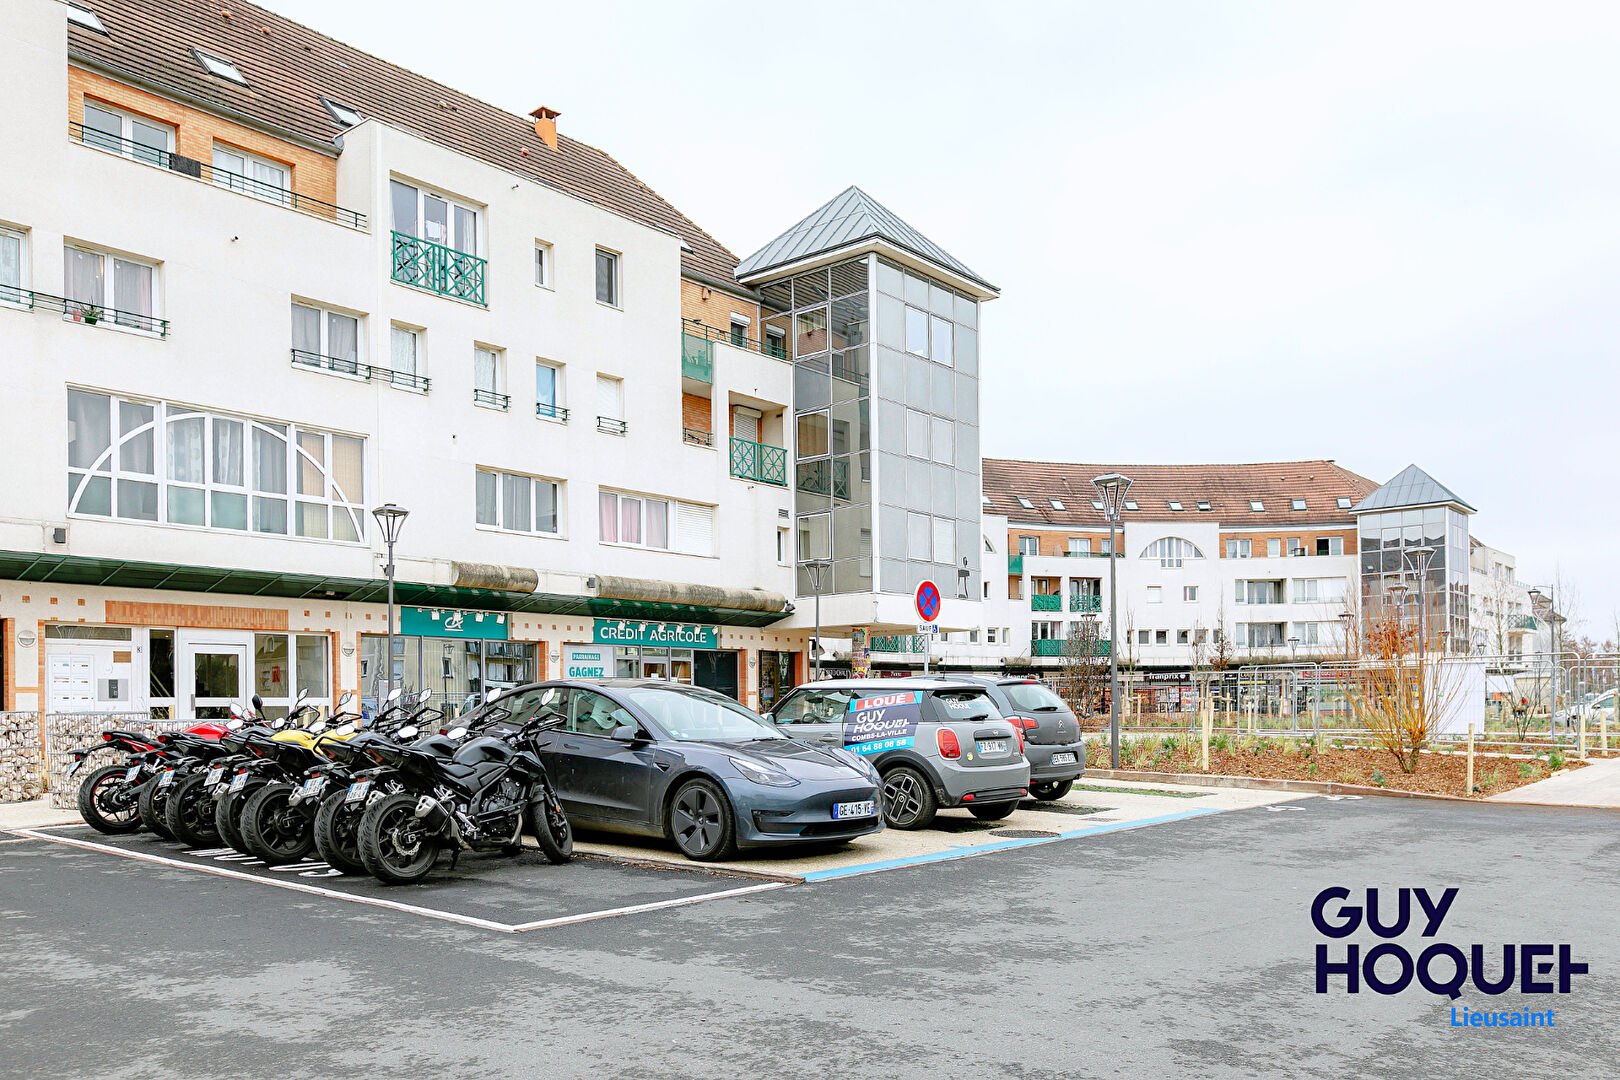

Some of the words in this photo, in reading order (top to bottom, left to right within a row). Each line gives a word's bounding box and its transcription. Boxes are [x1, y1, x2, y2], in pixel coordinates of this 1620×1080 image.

[649, 629, 707, 643] AGRICOLE
[569, 667, 604, 677] GAGNEZ
[1149, 672, 1179, 681] franprix
[857, 709, 886, 723] GUY
[851, 729, 908, 742] COMBS-LA-VILLE
[862, 743, 872, 752] 64
[873, 741, 883, 750] 88
[896, 738, 907, 747] 58
